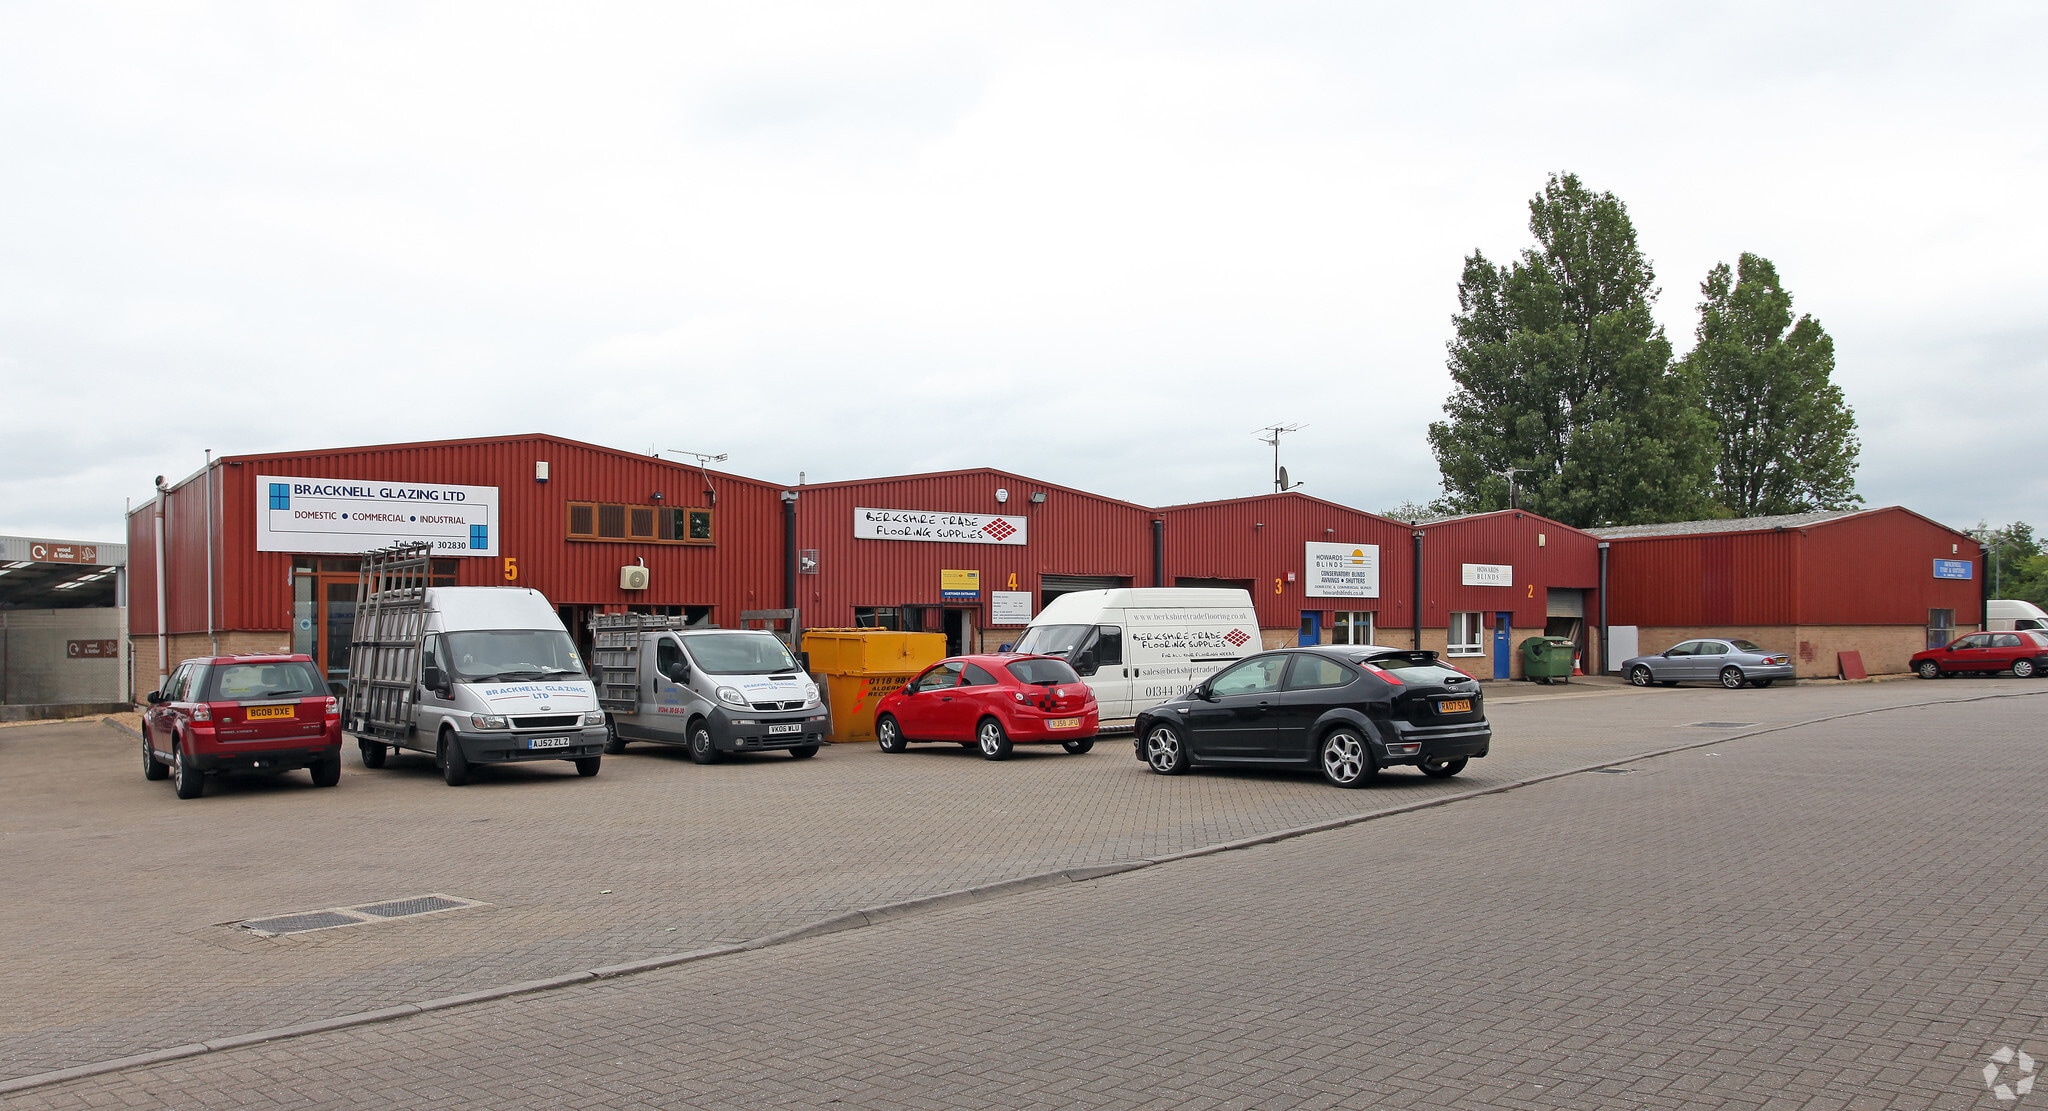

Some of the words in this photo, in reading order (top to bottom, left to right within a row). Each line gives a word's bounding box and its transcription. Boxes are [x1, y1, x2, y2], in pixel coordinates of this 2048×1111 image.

[294, 484, 375, 498] BRACKNELL
[379, 487, 439, 501] GLAZING
[443, 490, 466, 502] LTD
[294, 511, 337, 520] DOMESTIC
[352, 512, 406, 523] COMMERCIAL
[420, 515, 466, 525] INDUSTRIAL
[865, 512, 936, 525] BERKSHIRE
[941, 515, 979, 527] TRADE
[876, 526, 931, 538] FLOORING
[936, 529, 983, 539] SUPPLIES
[437, 541, 466, 550] 302830
[504, 557, 518, 581] 5
[1007, 572, 1018, 591] 4
[1275, 578, 1283, 595] 3
[1527, 584, 1534, 598] 2
[1133, 612, 1248, 621] www.berkshiretradeflooring.co.uk
[1132, 631, 1189, 641] BERKSHIRE
[1191, 631, 1222, 640] TRADE
[1142, 640, 1186, 649] FLOORING
[1188, 640, 1226, 648] SUPPLIES
[869, 677, 892, 685] 0118
[485, 685, 542, 696] BRACKNELL
[545, 685, 586, 693] GLAZING
[1145, 686, 1173, 697] 01344
[1441, 701, 1456, 711] RA07
[1458, 700, 1470, 710] SXX
[250, 708, 272, 717] BG08
[274, 707, 290, 715] DXE
[533, 739, 553, 748] AJ52
[554, 737, 569, 746] ZLZ
